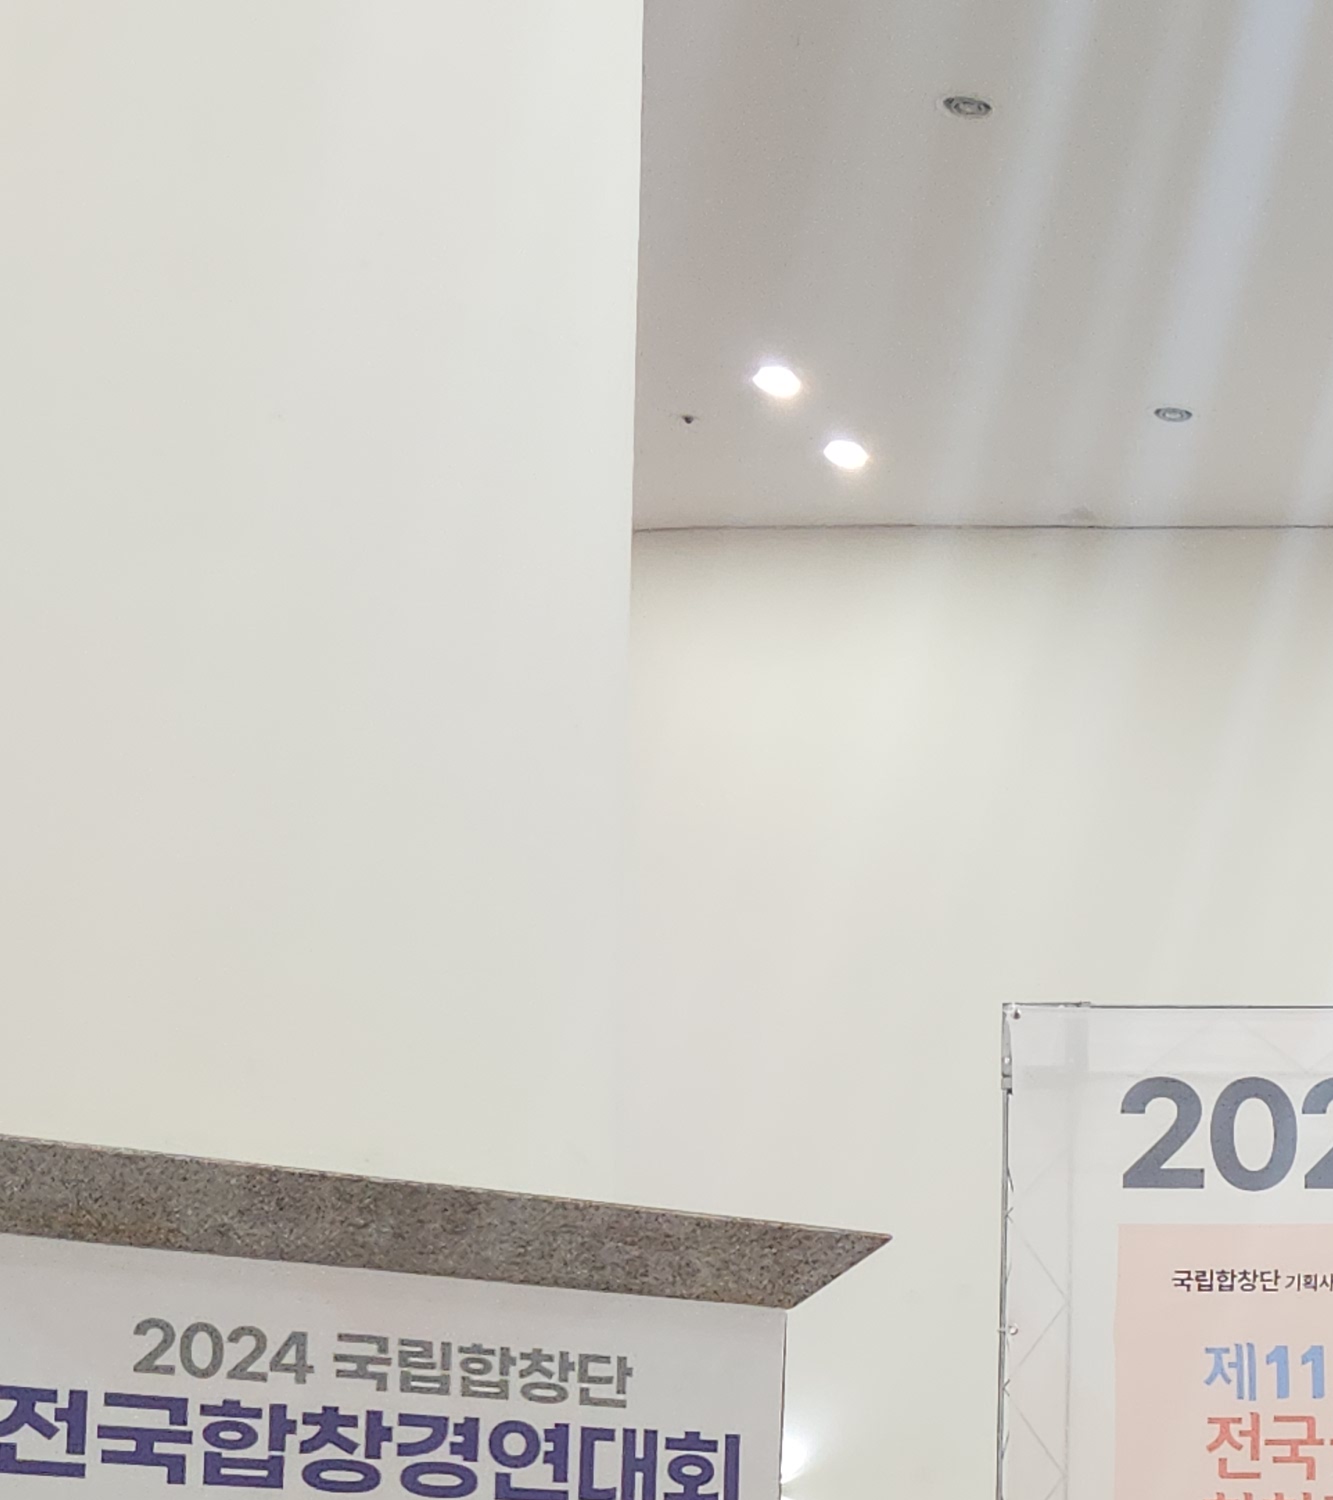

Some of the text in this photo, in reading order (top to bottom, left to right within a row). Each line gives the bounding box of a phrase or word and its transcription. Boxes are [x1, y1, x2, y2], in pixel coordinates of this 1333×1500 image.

[1171, 1268, 1281, 1294] 국립합창단
[133, 1317, 634, 1409] 2024 국립합창단
